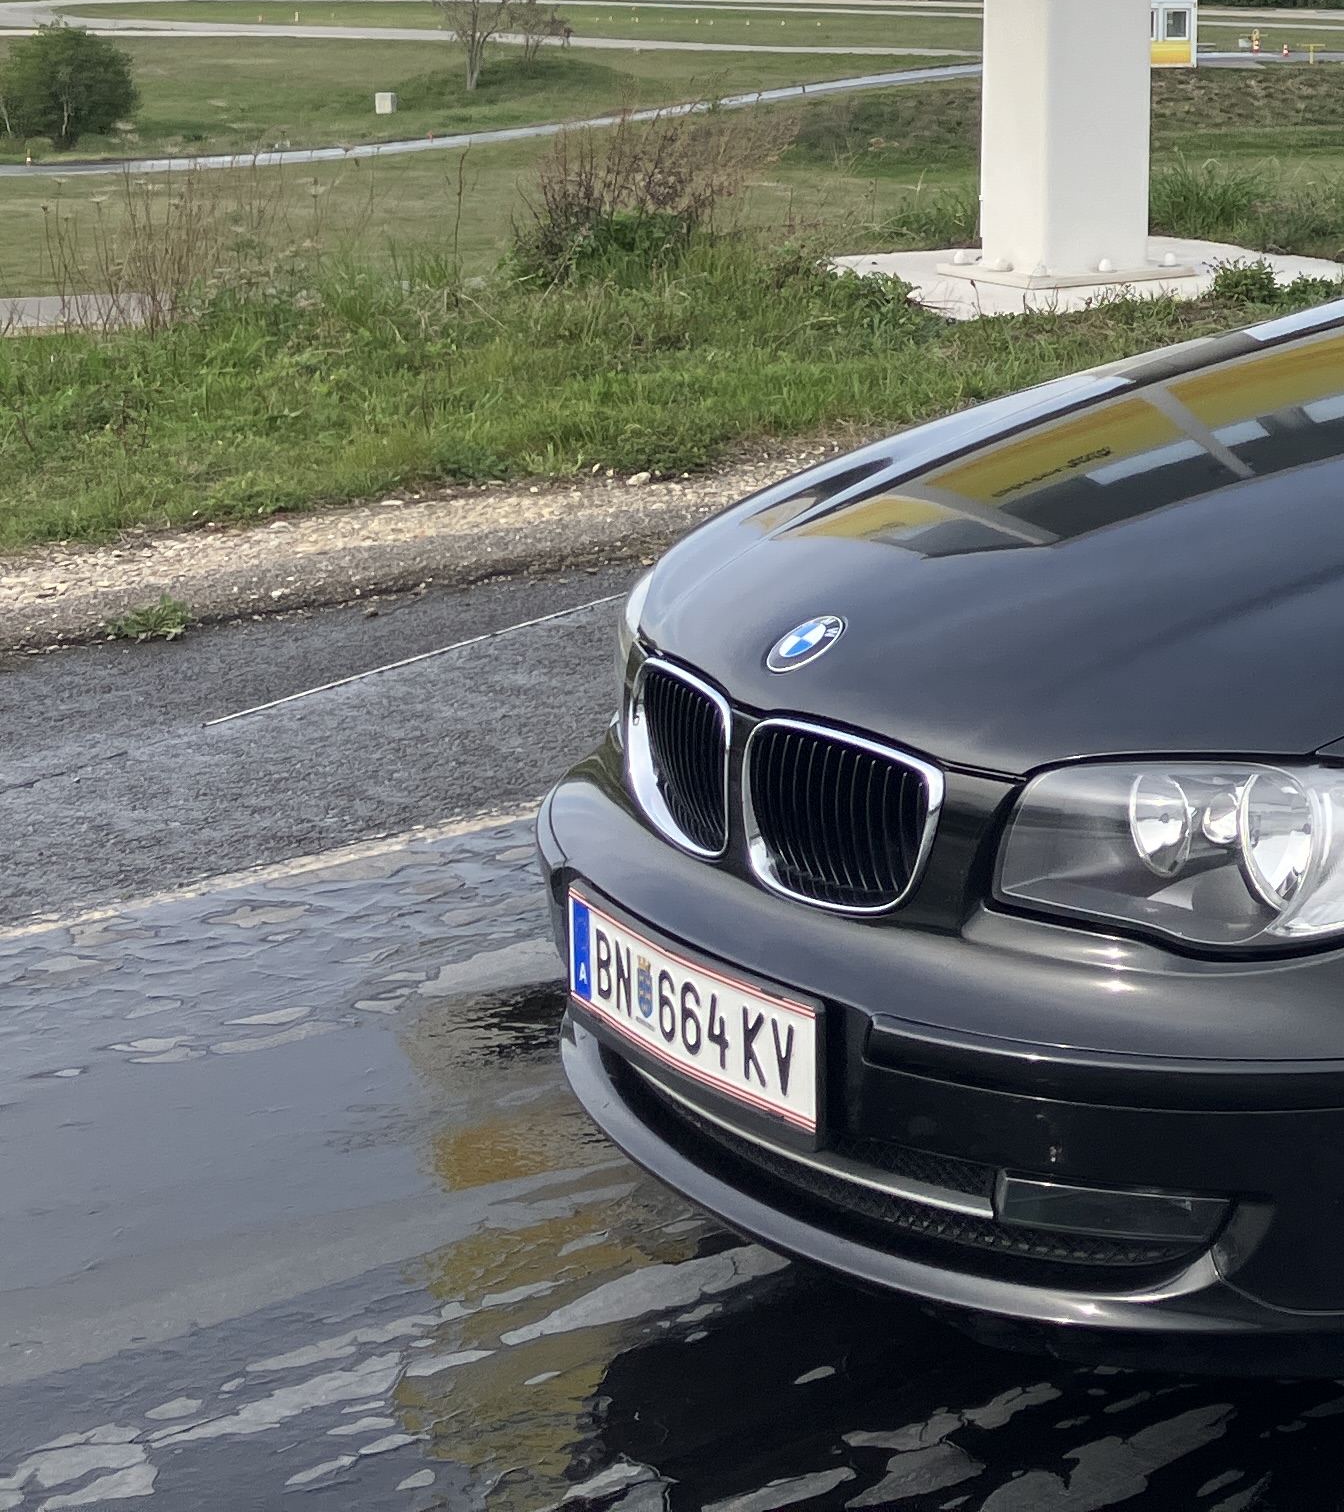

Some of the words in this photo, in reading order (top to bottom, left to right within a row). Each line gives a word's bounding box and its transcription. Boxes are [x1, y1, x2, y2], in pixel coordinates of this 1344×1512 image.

[578, 962, 588, 984] A
[596, 927, 633, 1018] BN
[657, 969, 729, 1070] 664
[741, 1005, 795, 1098] KV
